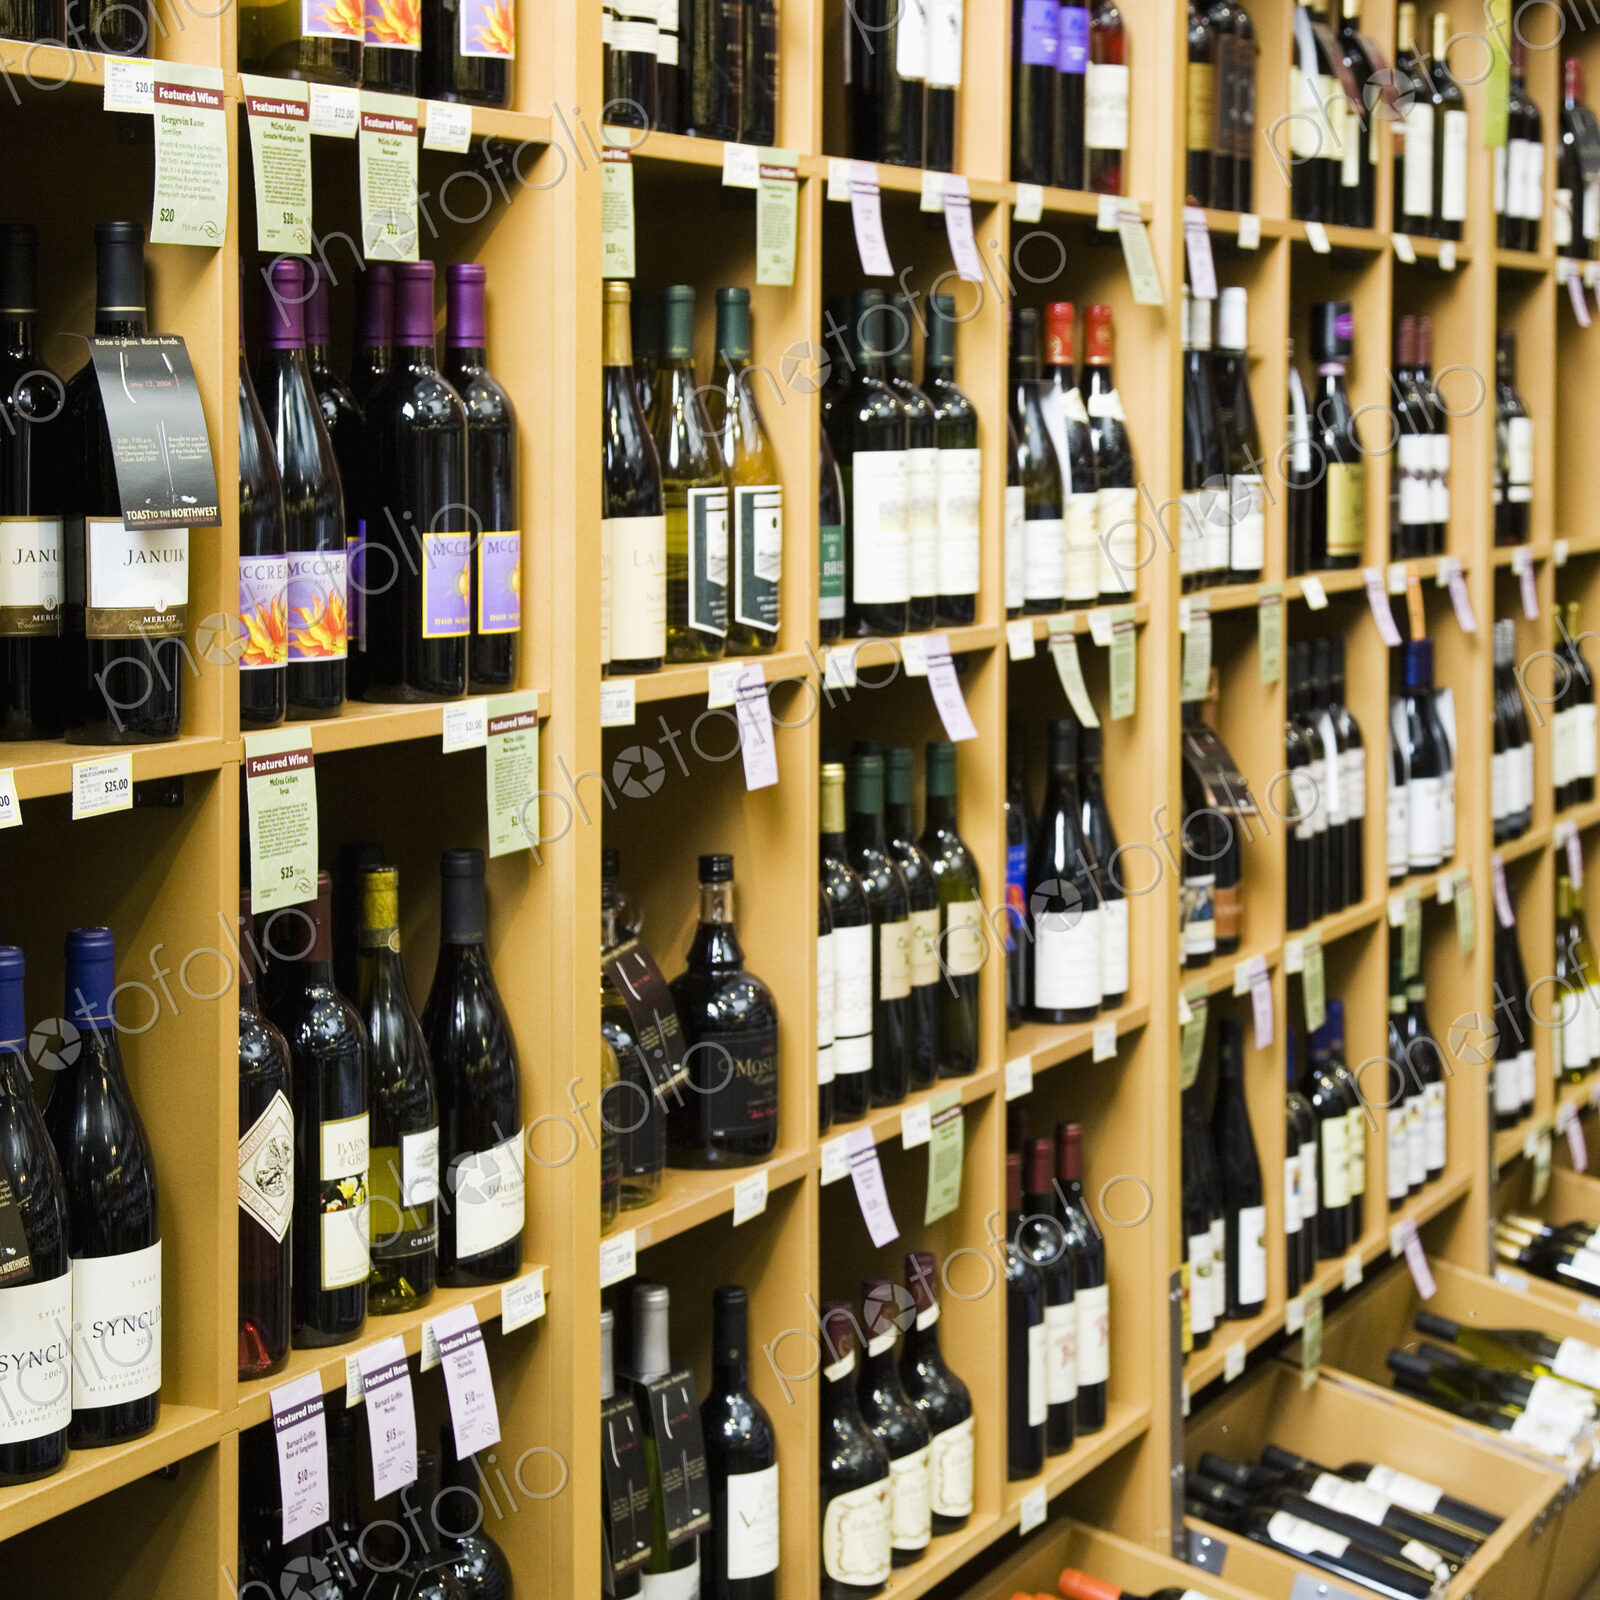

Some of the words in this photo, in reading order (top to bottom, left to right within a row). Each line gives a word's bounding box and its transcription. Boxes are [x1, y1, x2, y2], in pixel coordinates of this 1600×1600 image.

[159, 87, 196, 102] Featured
[196, 91, 219, 105] Wine
[252, 100, 285, 114] Featured
[285, 104, 305, 117] Wine
[161, 114, 189, 126] Bergevin
[189, 118, 205, 127] Lane
[364, 116, 395, 130] Featured
[395, 120, 413, 132] Wine
[160, 208, 175, 222] $20
[283, 212, 294, 225] $28
[95, 338, 114, 346] Raise
[121, 339, 140, 348] glass.
[141, 338, 159, 346] Raise
[160, 337, 180, 345] funds.
[126, 510, 150, 521] TOAST
[150, 510, 159, 519] TO
[159, 510, 171, 518] THE
[171, 506, 218, 518] NORTHWEST
[123, 548, 185, 566] JANUIK
[143, 615, 176, 623] MERLOT
[490, 717, 518, 732] Featured
[518, 714, 534, 726] Wine
[252, 756, 287, 773] Featured
[288, 754, 309, 767] Wine
[104, 778, 128, 793] $25.00
[280, 866, 294, 880] $25
[440, 1337, 467, 1353] Featured
[364, 1369, 393, 1388] Featured
[393, 1363, 408, 1378] Item
[276, 1406, 308, 1428] Featured
[308, 1400, 324, 1415] Item
[286, 1436, 303, 1450] Barnard
[303, 1429, 317, 1444] Griffin
[386, 1427, 397, 1443] $15
[297, 1469, 308, 1485] $10
